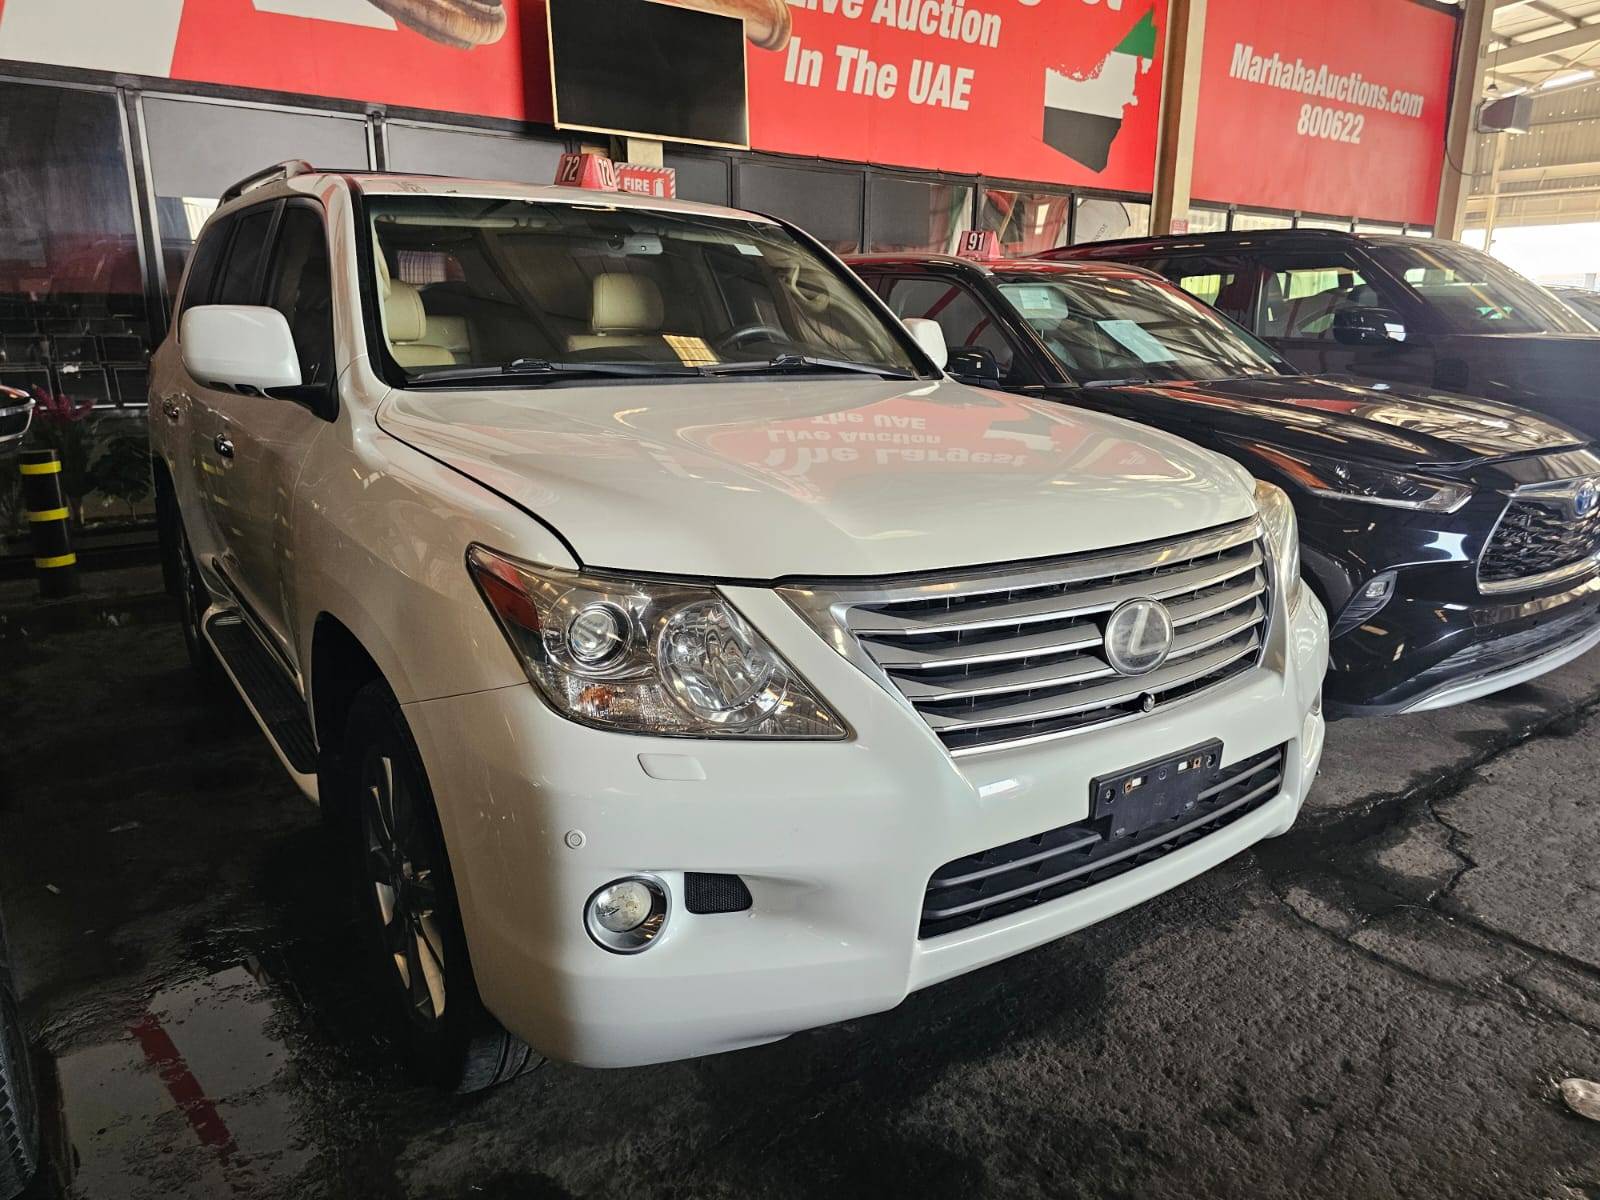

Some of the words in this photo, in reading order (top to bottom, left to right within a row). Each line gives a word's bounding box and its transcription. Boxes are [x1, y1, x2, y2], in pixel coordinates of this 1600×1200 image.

[871, 0, 1001, 48] Auction
[784, 36, 823, 88] In
[836, 45, 898, 99] The
[908, 59, 974, 111] UAE
[1229, 42, 1425, 118] MarhabaAuctions.com
[1297, 104, 1365, 144] 800622
[562, 156, 580, 182] 72
[624, 177, 650, 192] FIRE
[968, 232, 985, 251] 91
